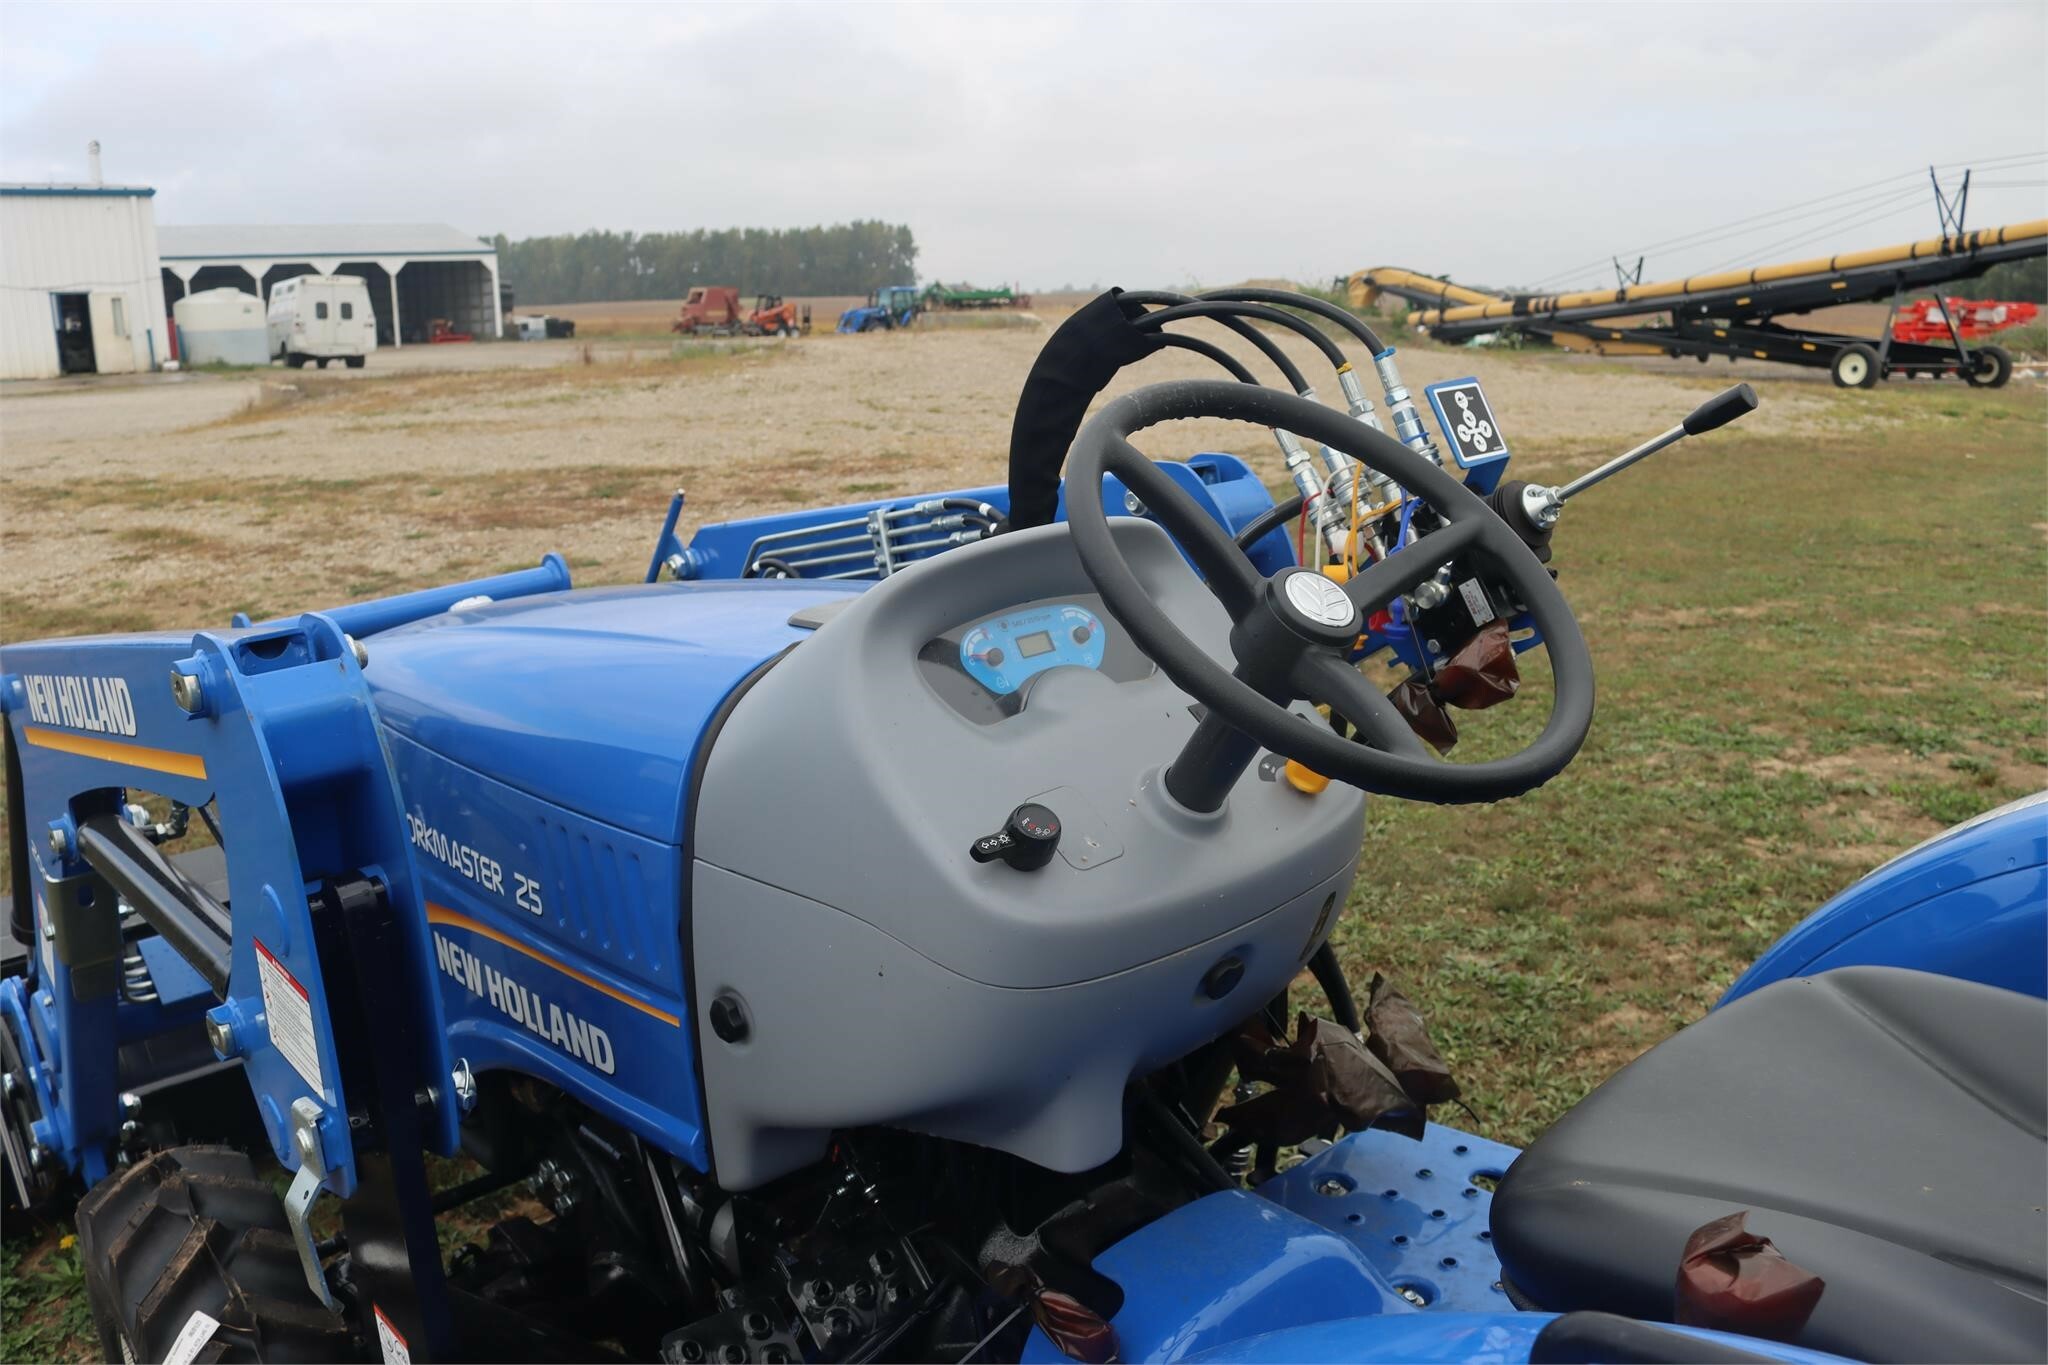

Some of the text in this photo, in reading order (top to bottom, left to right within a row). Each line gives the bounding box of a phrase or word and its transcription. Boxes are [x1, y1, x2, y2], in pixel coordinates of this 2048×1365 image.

[24, 675, 136, 737] NEW HOLLAND
[406, 813, 543, 915] ORKMASTER 25
[434, 930, 615, 1076] NEW HOLLAND
